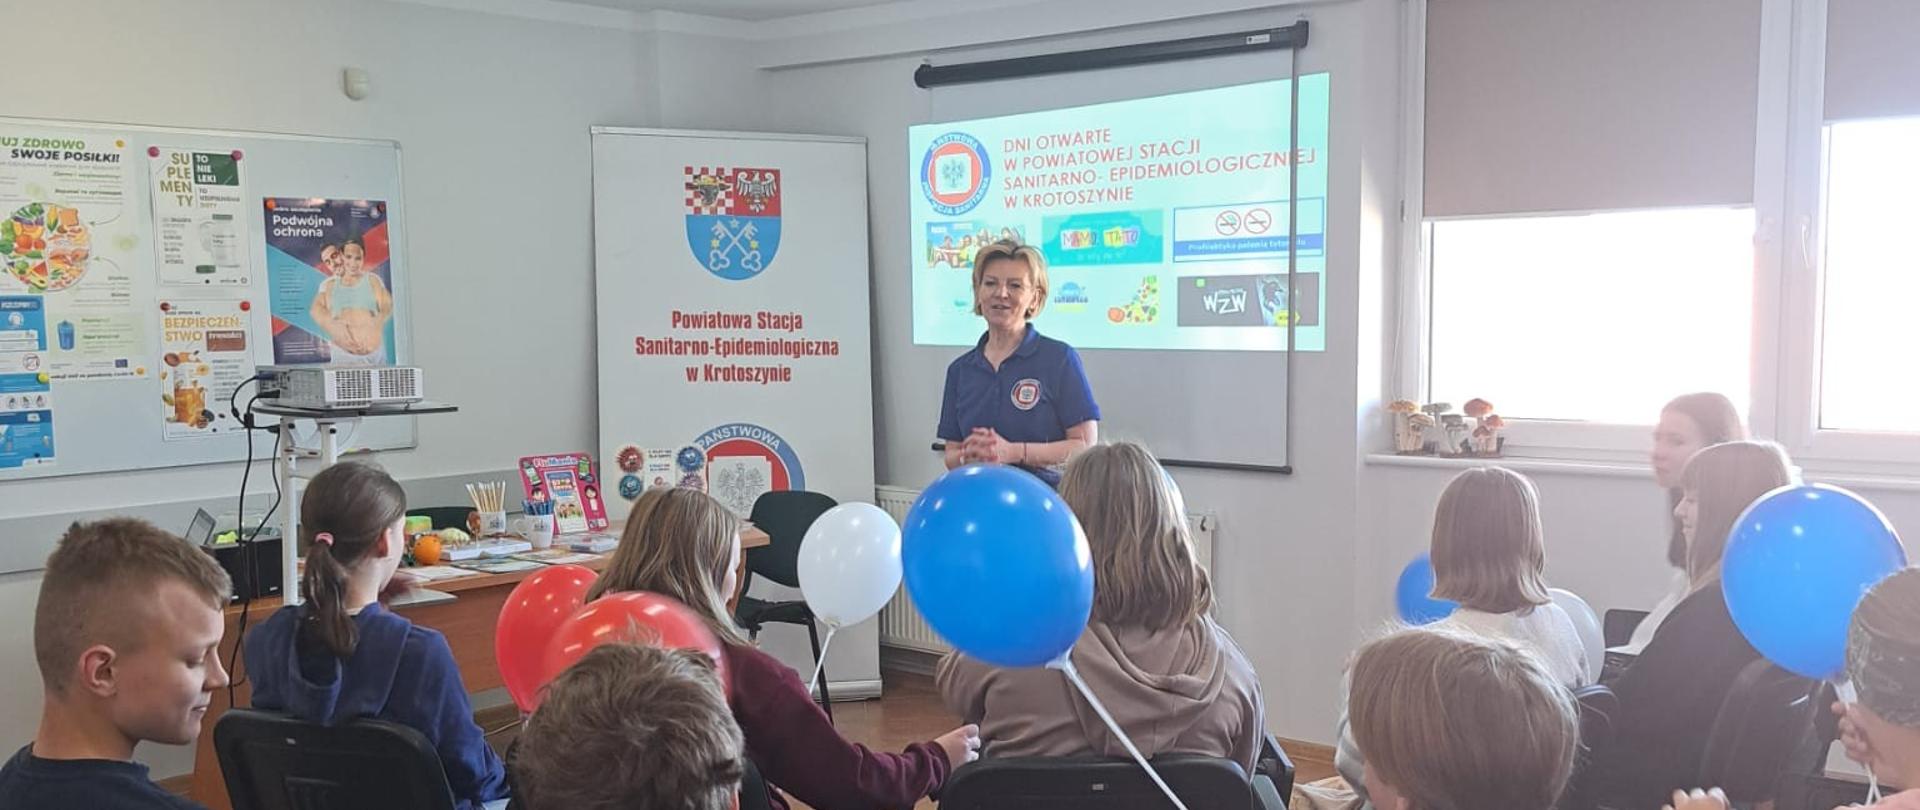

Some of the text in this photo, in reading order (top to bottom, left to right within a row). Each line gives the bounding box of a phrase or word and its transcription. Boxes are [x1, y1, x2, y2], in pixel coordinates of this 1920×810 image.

[0, 136, 85, 150] UJ ZDROWO
[1004, 128, 1111, 153] DNI OTWARTE
[11, 149, 120, 163] SWOJE POSIŁKI!
[171, 152, 190, 165] SU
[195, 154, 209, 163] TO
[1004, 139, 1200, 171] W POWIATOWEJ STACJI
[167, 167, 191, 179] PLE
[1004, 169, 1103, 190] SANITARNO-
[160, 181, 192, 193] MEN
[176, 195, 193, 207] TY
[1004, 186, 1133, 208] W KROTOSZYNIE
[273, 215, 333, 227] Podwójna
[273, 226, 323, 237] ochrona
[672, 310, 803, 332] Powiatowa Stacja
[165, 331, 202, 341] STWO
[635, 336, 839, 359] Sanitarno-Epidemiologiczna
[686, 364, 791, 384] w Krotoszynie
